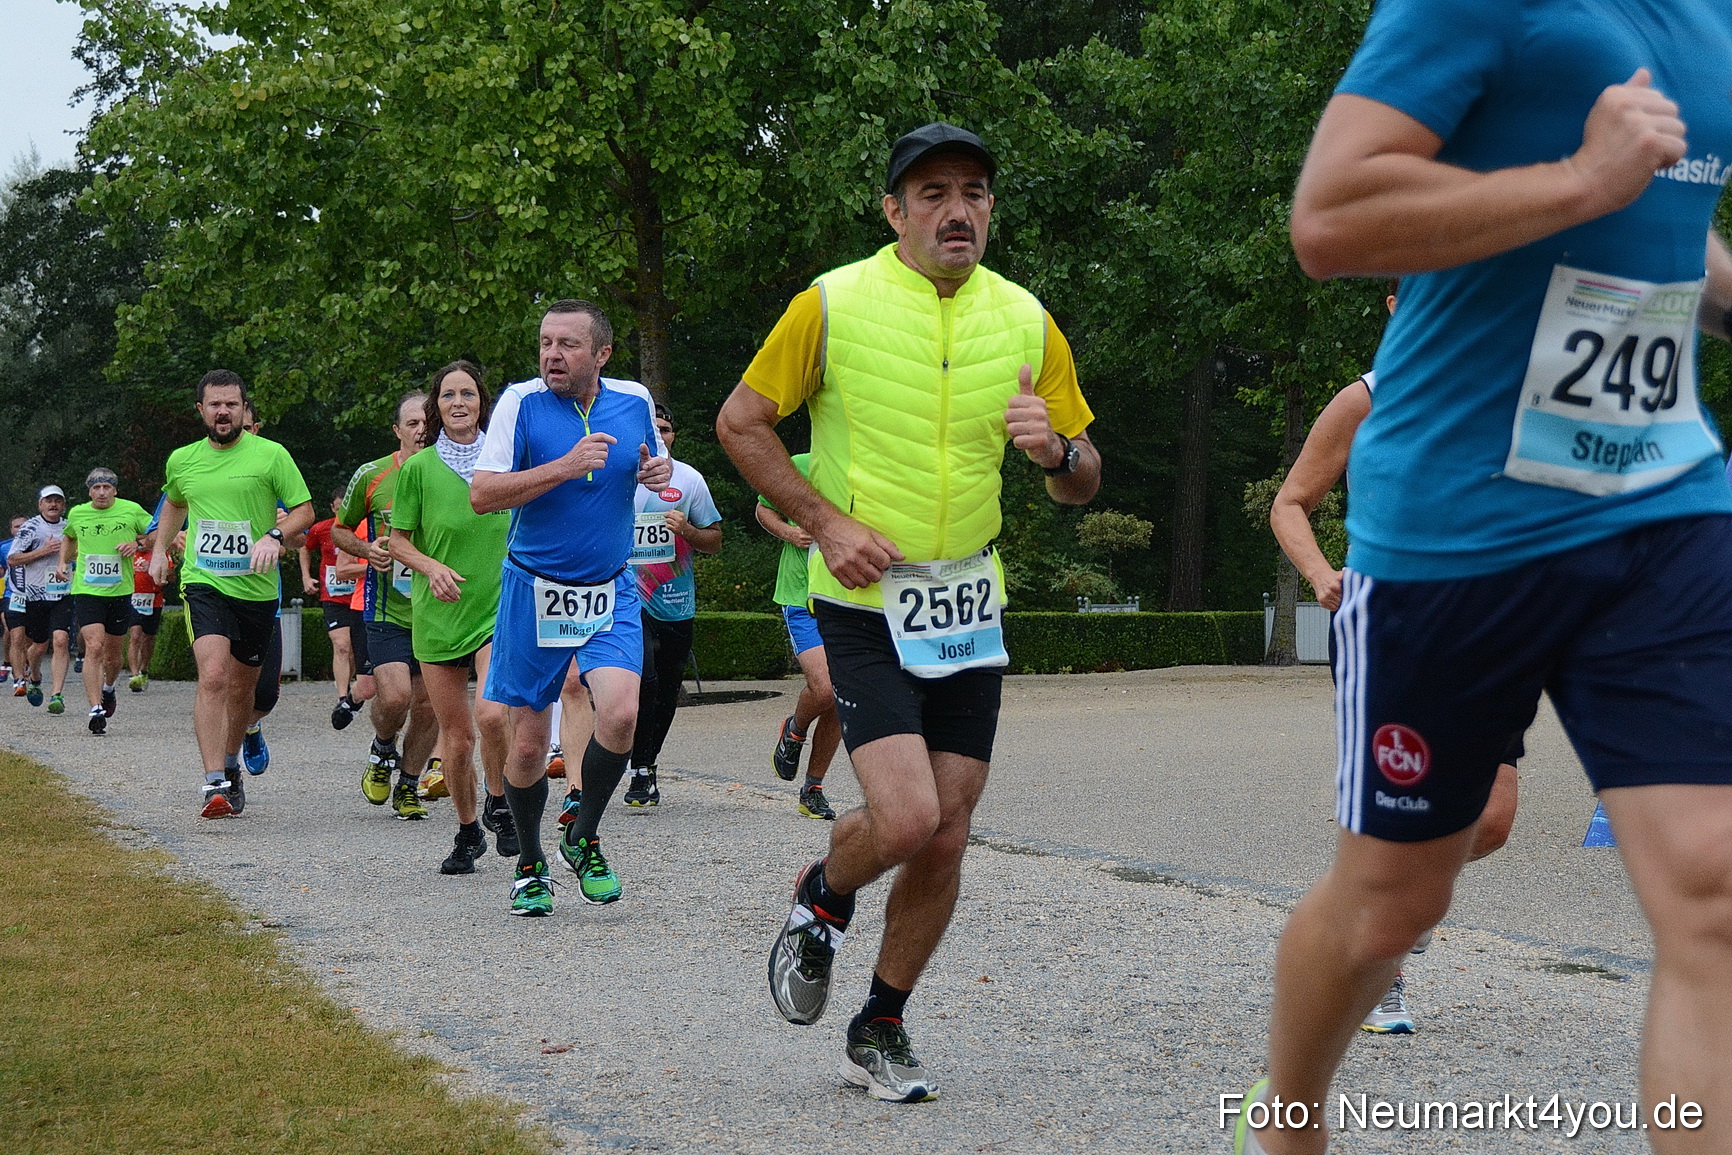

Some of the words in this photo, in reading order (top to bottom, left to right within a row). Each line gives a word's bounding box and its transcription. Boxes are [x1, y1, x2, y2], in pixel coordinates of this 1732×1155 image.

[200, 533, 249, 555] 2248
[89, 562, 119, 575] 3054
[205, 559, 241, 569] Christian
[545, 589, 608, 618] 2610
[899, 578, 993, 633] 2562
[938, 637, 975, 660] Josef
[1378, 744, 1422, 773] FCN
[1397, 796, 1430, 811] Club
